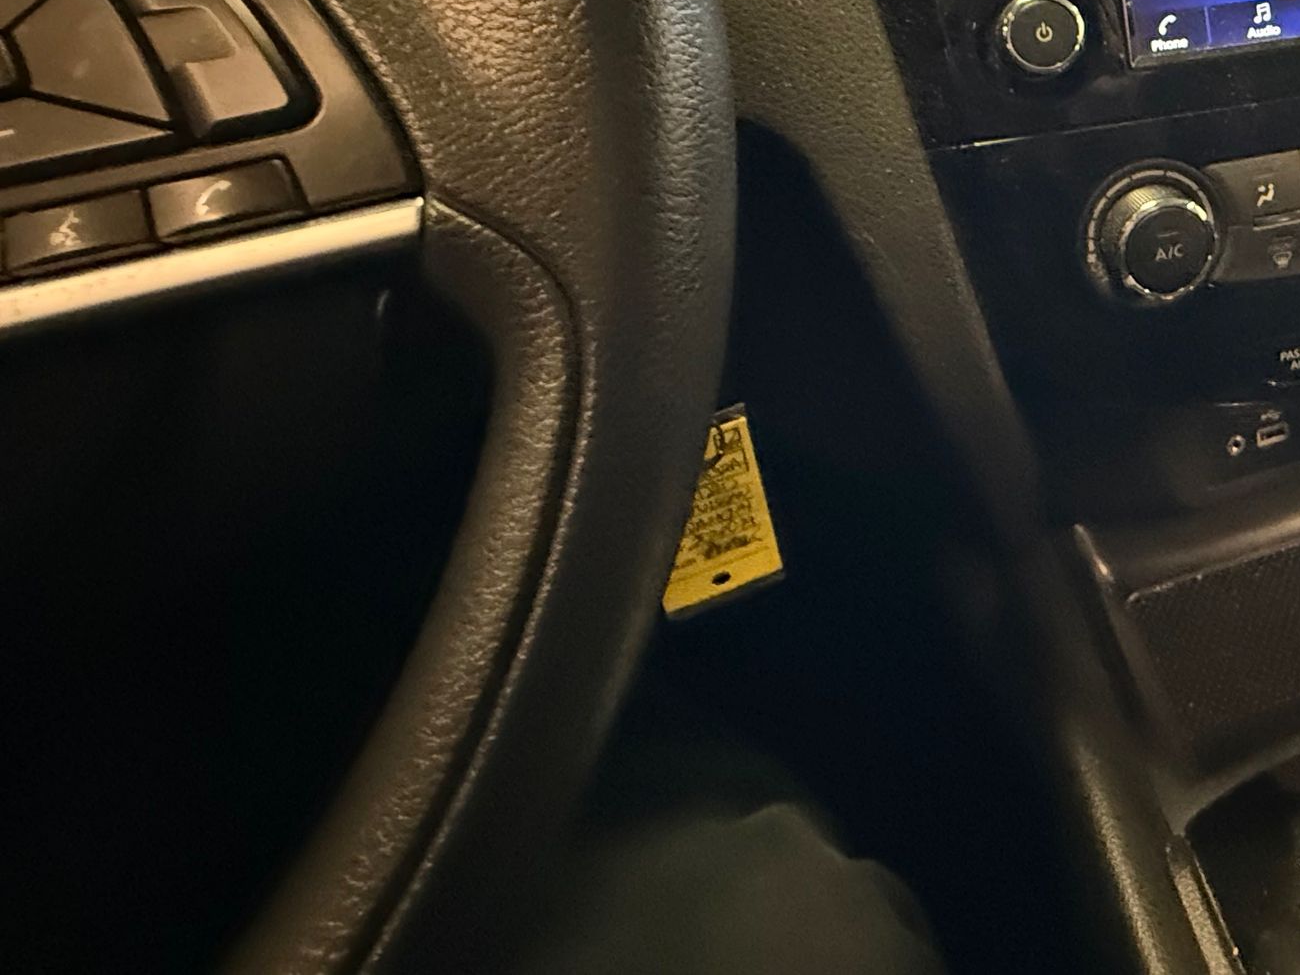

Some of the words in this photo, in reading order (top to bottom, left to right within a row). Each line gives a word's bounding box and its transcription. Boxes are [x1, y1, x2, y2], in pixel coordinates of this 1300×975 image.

[1246, 24, 1282, 40] Audio
[1150, 37, 1189, 53] Phone
[1154, 243, 1184, 262] A/C
